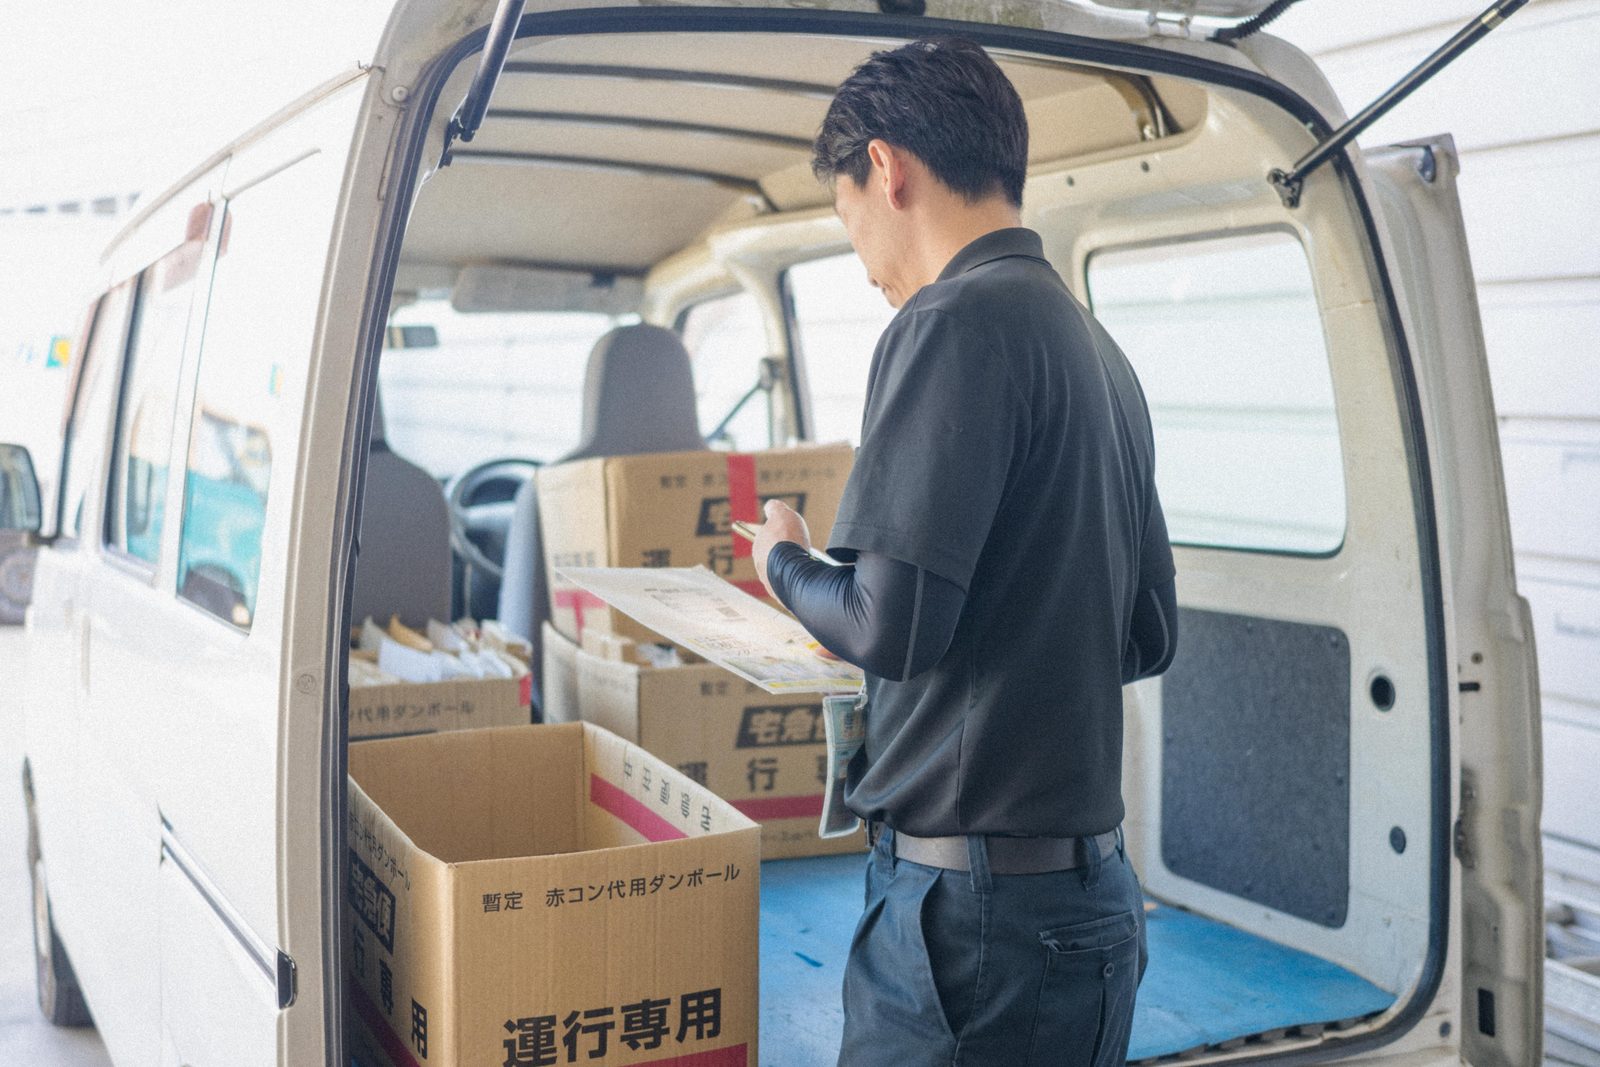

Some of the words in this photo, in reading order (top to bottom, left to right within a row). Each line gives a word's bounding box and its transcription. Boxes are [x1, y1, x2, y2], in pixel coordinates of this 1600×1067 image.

[482, 891, 524, 913] 暫定
[545, 863, 741, 908] 赤コン代用ダンボール
[503, 988, 722, 1067] 運行専用
